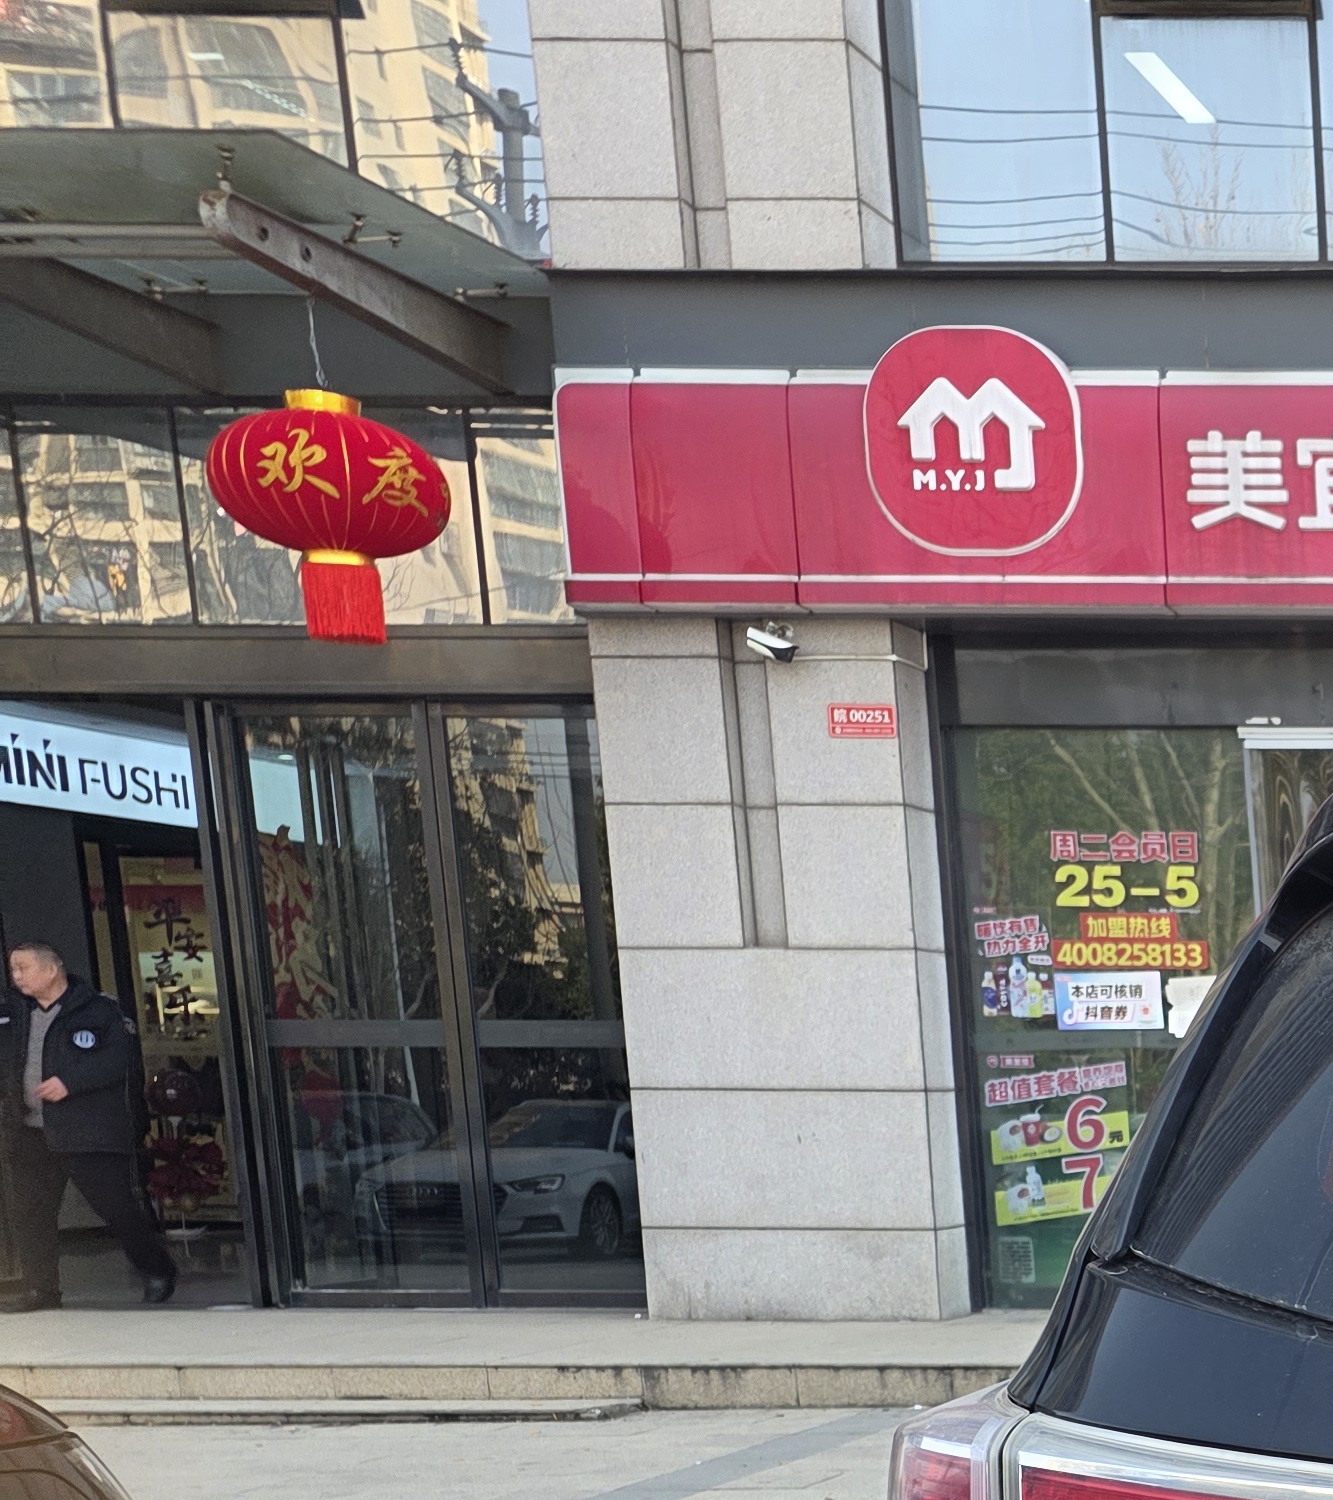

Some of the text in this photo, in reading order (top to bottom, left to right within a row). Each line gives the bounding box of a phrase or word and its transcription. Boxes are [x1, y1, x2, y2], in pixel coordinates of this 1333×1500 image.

[912, 468, 985, 491] M.Y.J
[849, 709, 891, 723] 00251
[78, 758, 190, 810] FUSHI
[1050, 830, 1199, 864] 周二会员日
[1086, 916, 1172, 939] 加盟热线
[1056, 942, 1204, 968] 4008258133
[1071, 984, 1143, 999] 本店可核销
[986, 1069, 1081, 1106] 超值套餐
[1065, 1096, 1106, 1152] 6
[1062, 1154, 1103, 1212] 7
